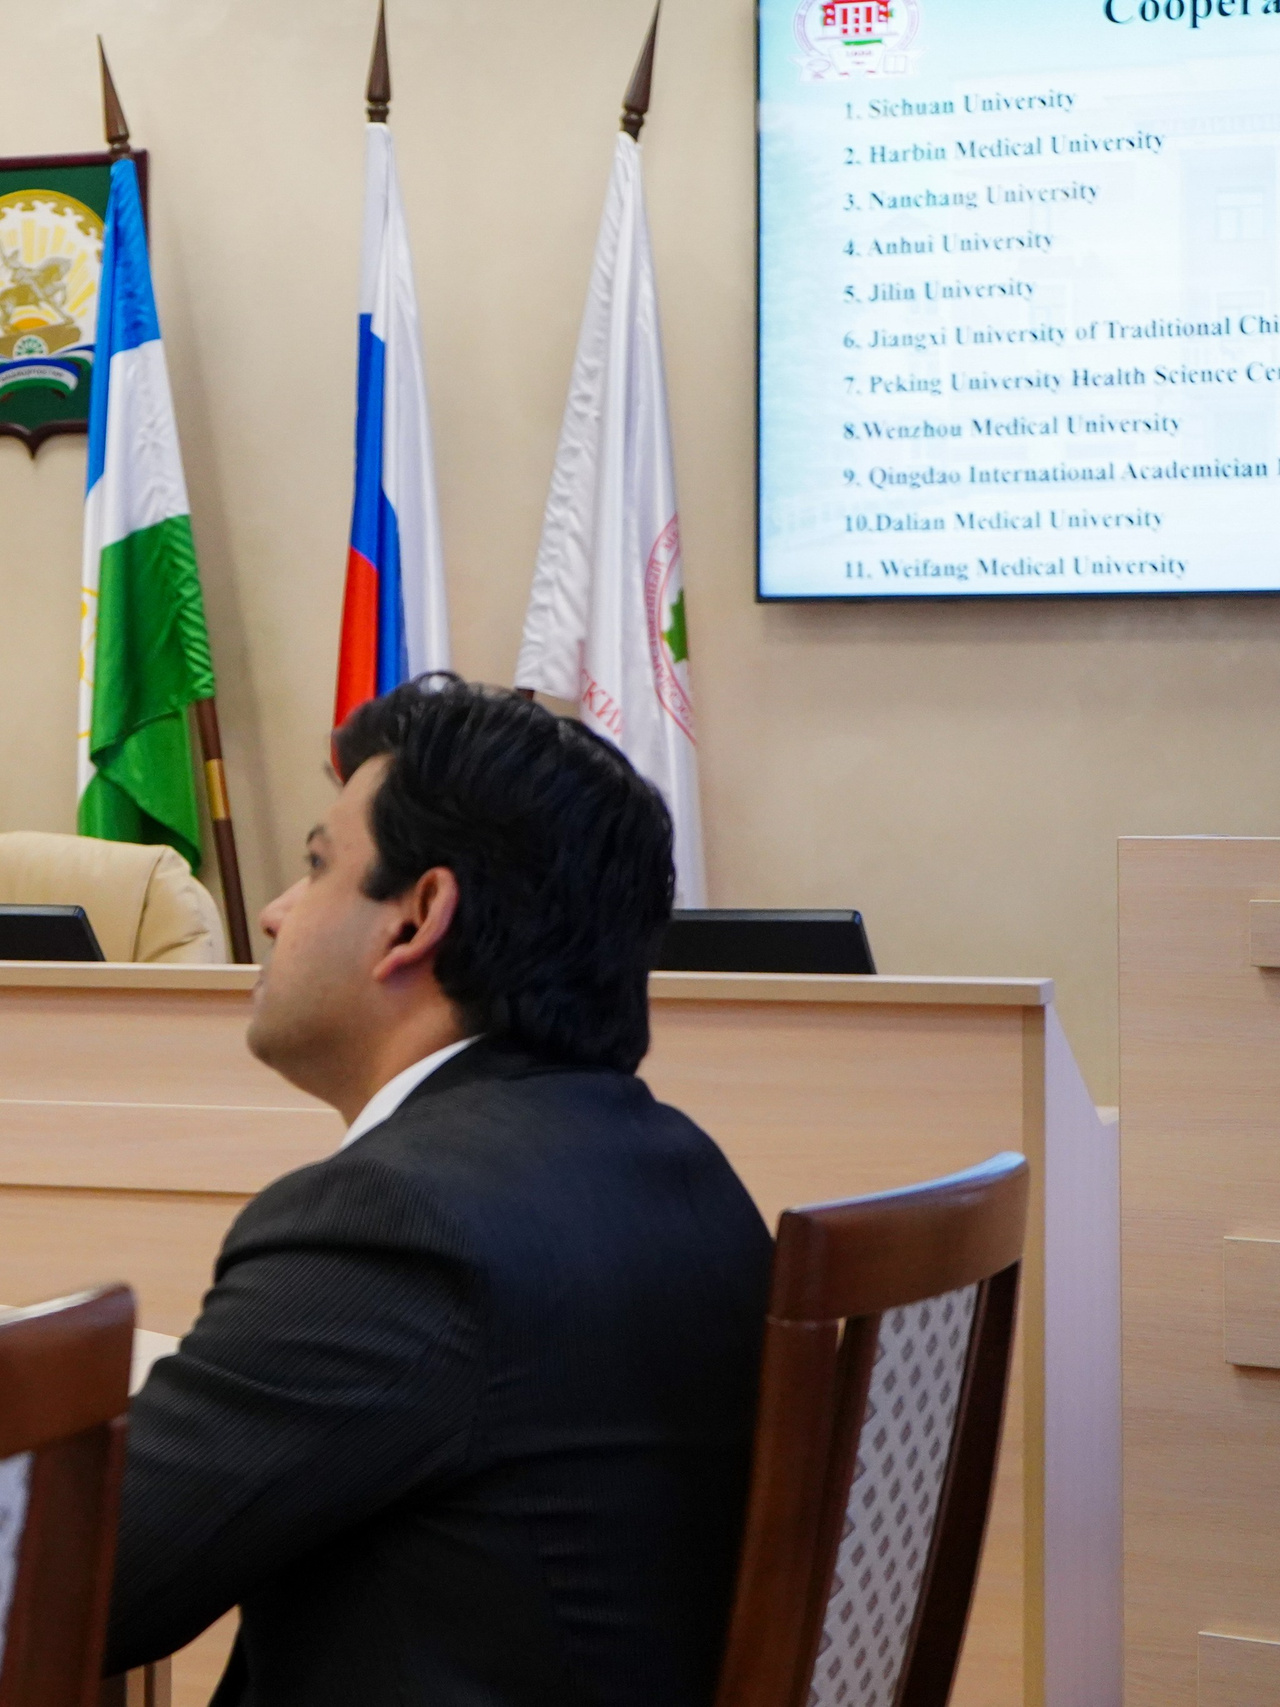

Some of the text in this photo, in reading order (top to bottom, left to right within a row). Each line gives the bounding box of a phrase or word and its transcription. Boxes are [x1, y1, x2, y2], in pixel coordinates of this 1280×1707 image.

[1103, 0, 1280, 29] Coopera
[868, 98, 955, 118] Sichuan
[964, 89, 1075, 113] University
[870, 142, 947, 165] Harbin
[955, 136, 1042, 159] Medical
[1051, 130, 1164, 154] University
[870, 189, 979, 210] Nanchang
[987, 181, 1097, 204] University
[868, 235, 933, 256] Anhui
[942, 230, 1053, 253] University
[868, 283, 917, 303] Jilin
[924, 278, 1034, 301] University
[868, 327, 946, 352] Jiangxi
[955, 323, 1065, 346] University
[1075, 321, 1099, 340] of
[1106, 316, 1231, 339] Traditional
[870, 374, 942, 396] Peking
[951, 371, 1061, 393] University
[1072, 367, 1146, 388] Health
[1154, 364, 1238, 385] Science
[1245, 362, 1280, 383] Ce
[971, 416, 1058, 437] Medical
[1067, 413, 1179, 436] University
[868, 466, 962, 490] Qingdao
[968, 462, 1115, 485] International
[1121, 458, 1268, 480] Academician
[954, 510, 1041, 530] Medical
[1050, 508, 1162, 531] University
[880, 559, 969, 581] Weifang
[977, 557, 1065, 577] Medical
[1073, 555, 1186, 578] University
